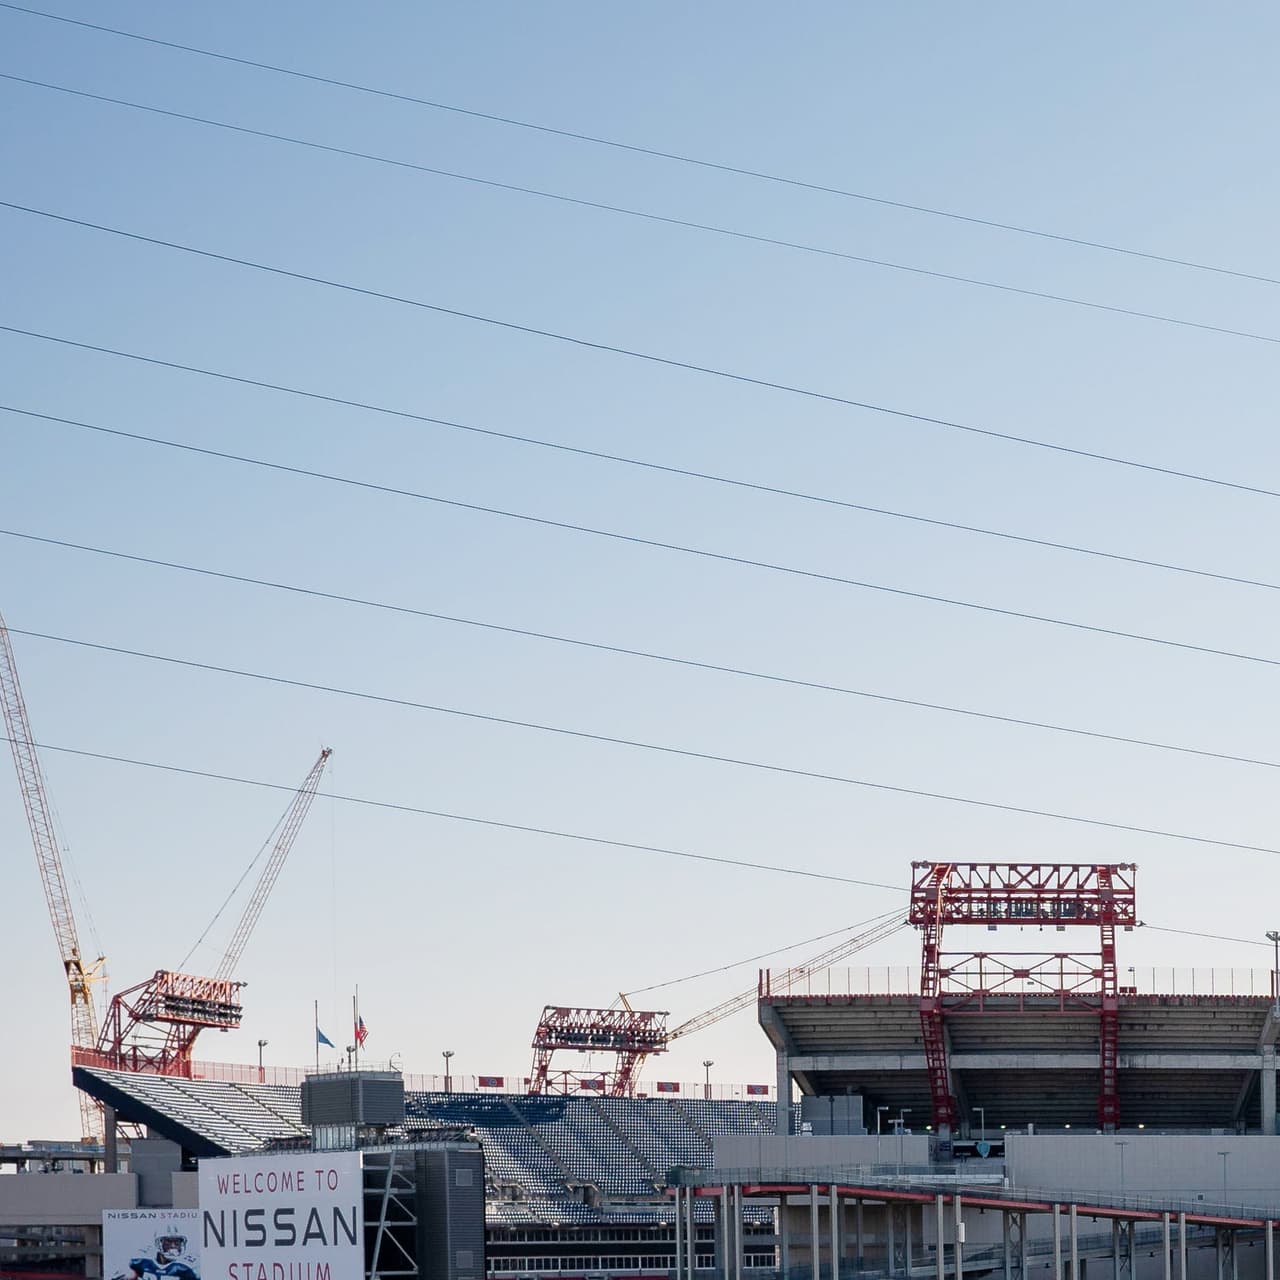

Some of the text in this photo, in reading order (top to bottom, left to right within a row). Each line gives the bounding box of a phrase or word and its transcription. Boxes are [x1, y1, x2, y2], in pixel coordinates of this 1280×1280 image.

[217, 1169, 339, 1194] WELCOME TO
[203, 1206, 357, 1248] NISSAN
